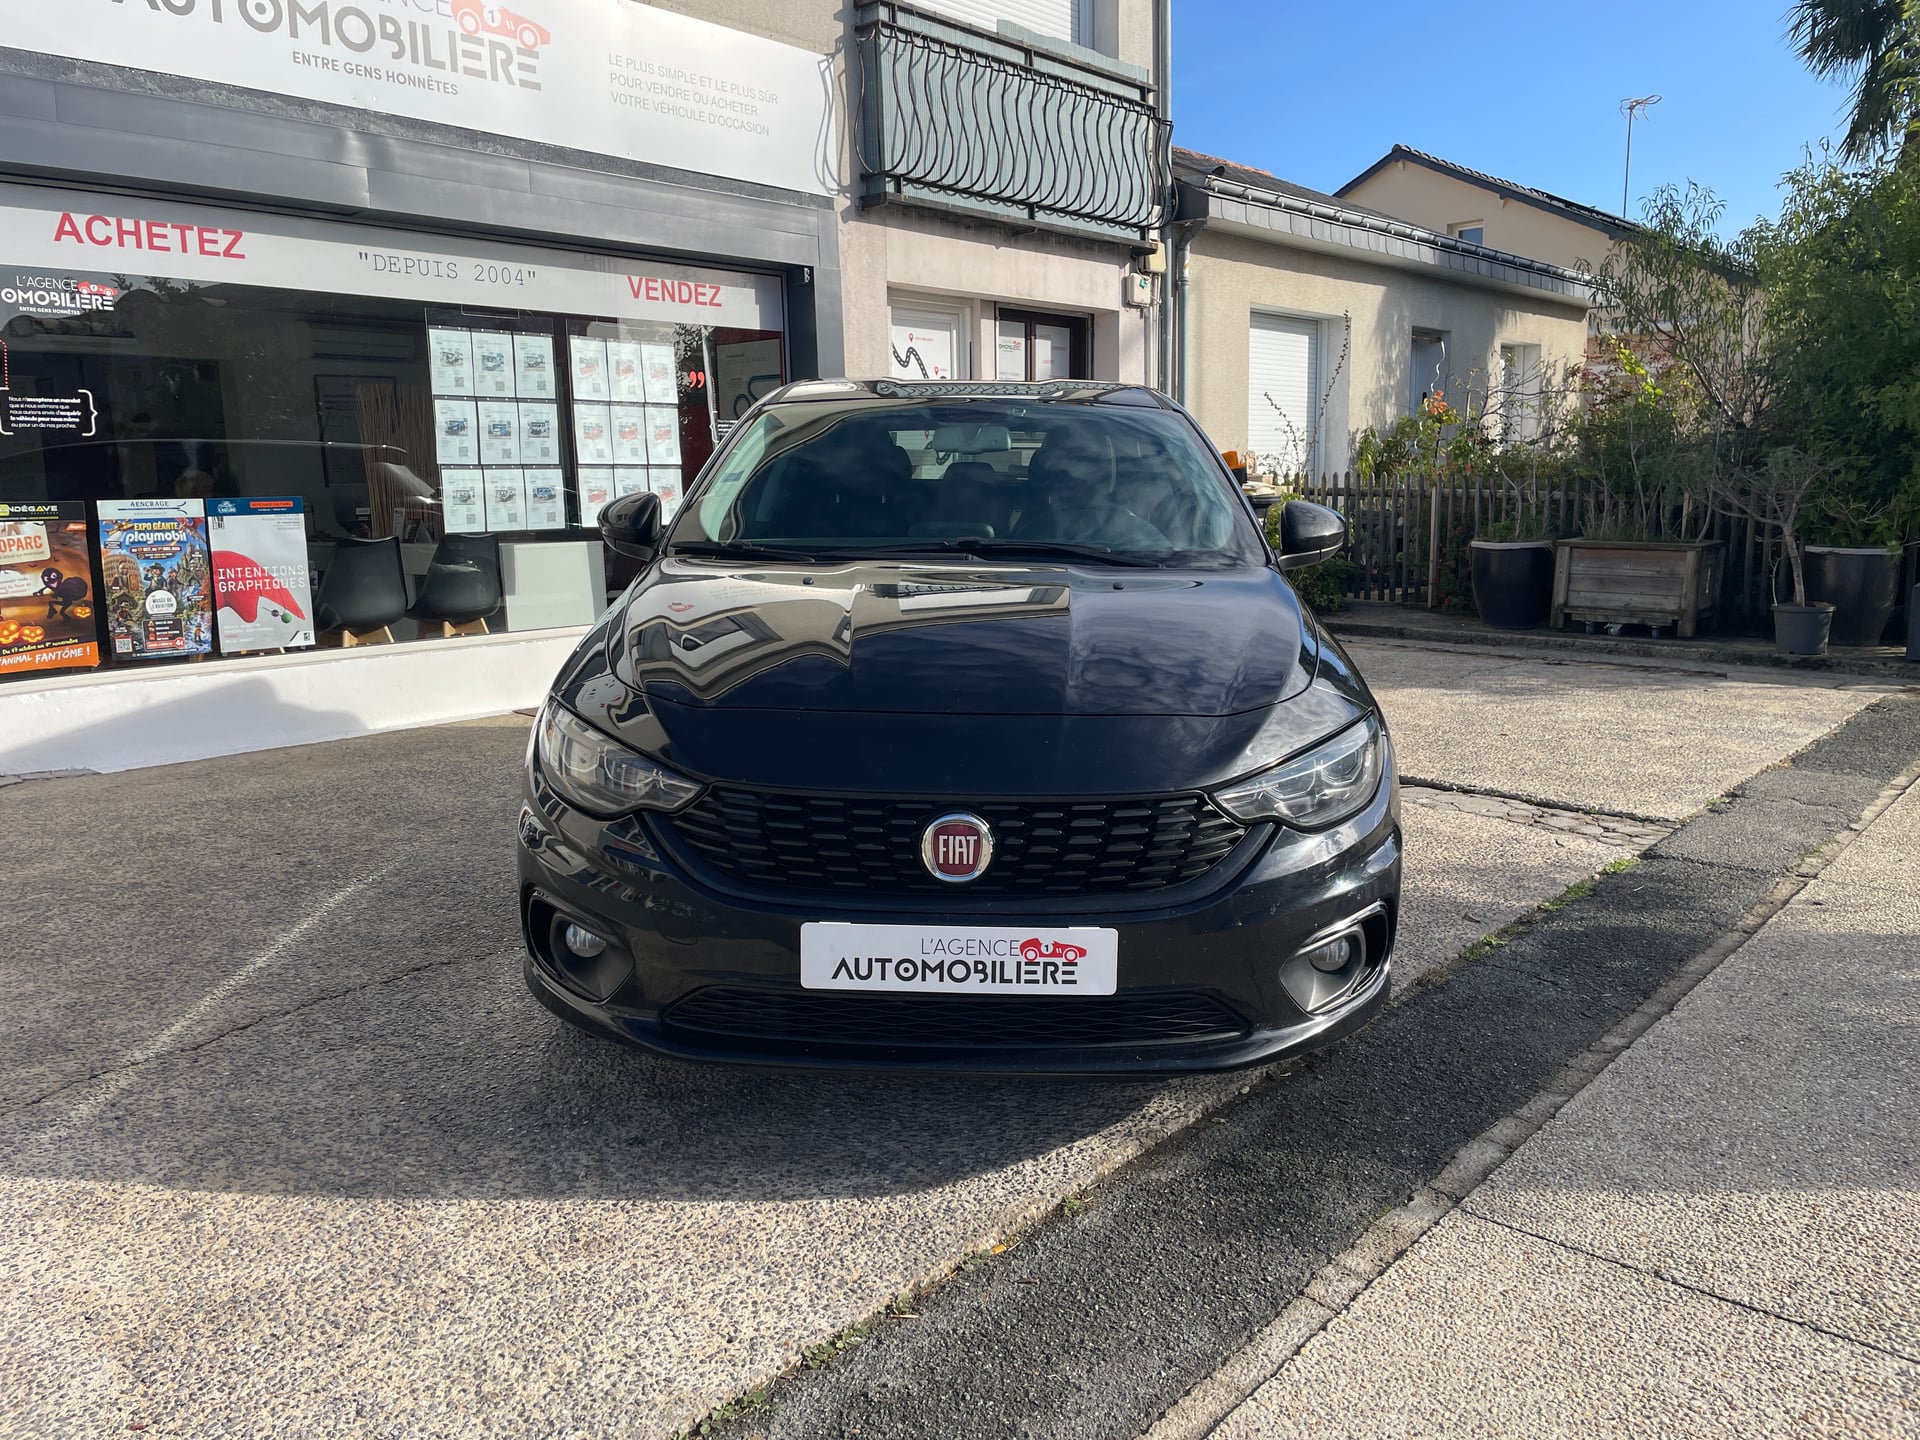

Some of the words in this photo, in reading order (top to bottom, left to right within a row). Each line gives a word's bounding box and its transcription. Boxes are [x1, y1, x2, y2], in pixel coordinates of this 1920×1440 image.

[112, 0, 542, 91] OMOBILIERE
[293, 51, 339, 71] ENTRE
[344, 62, 382, 80] GENS
[386, 70, 458, 95] HONNÊTES
[609, 53, 623, 67] LE
[626, 57, 655, 75] PLUS
[658, 65, 697, 86] SIMPLE
[700, 75, 713, 89] ET
[715, 79, 728, 93] LE
[730, 82, 757, 100] PLUS
[759, 89, 779, 105] SÛR
[610, 72, 643, 90] POUR
[647, 80, 690, 101] VENDRE
[693, 91, 709, 106] OU
[711, 95, 758, 117] ACHETER
[611, 90, 650, 111] VOTRE
[709, 114, 770, 137] D'OCCASION
[53, 212, 246, 260] ACHETEZ
[16, 275, 78, 292] L'AGENCE
[359, 252, 458, 280] "DEPUIS
[474, 265, 536, 286] 2004"
[627, 276, 723, 307] VENDEZ
[125, 530, 187, 545] playmobil
[134, 522, 152, 531] EXPO
[153, 520, 178, 531] GÉANTE
[218, 565, 304, 579] INTENTIONS
[219, 577, 306, 593] GRAPHIQUES
[35, 647, 84, 664] FANTÔME
[938, 835, 977, 865] FIAT
[921, 938, 1020, 957] L'AGENCE
[831, 957, 1078, 985] AUTOMOBILIERE
